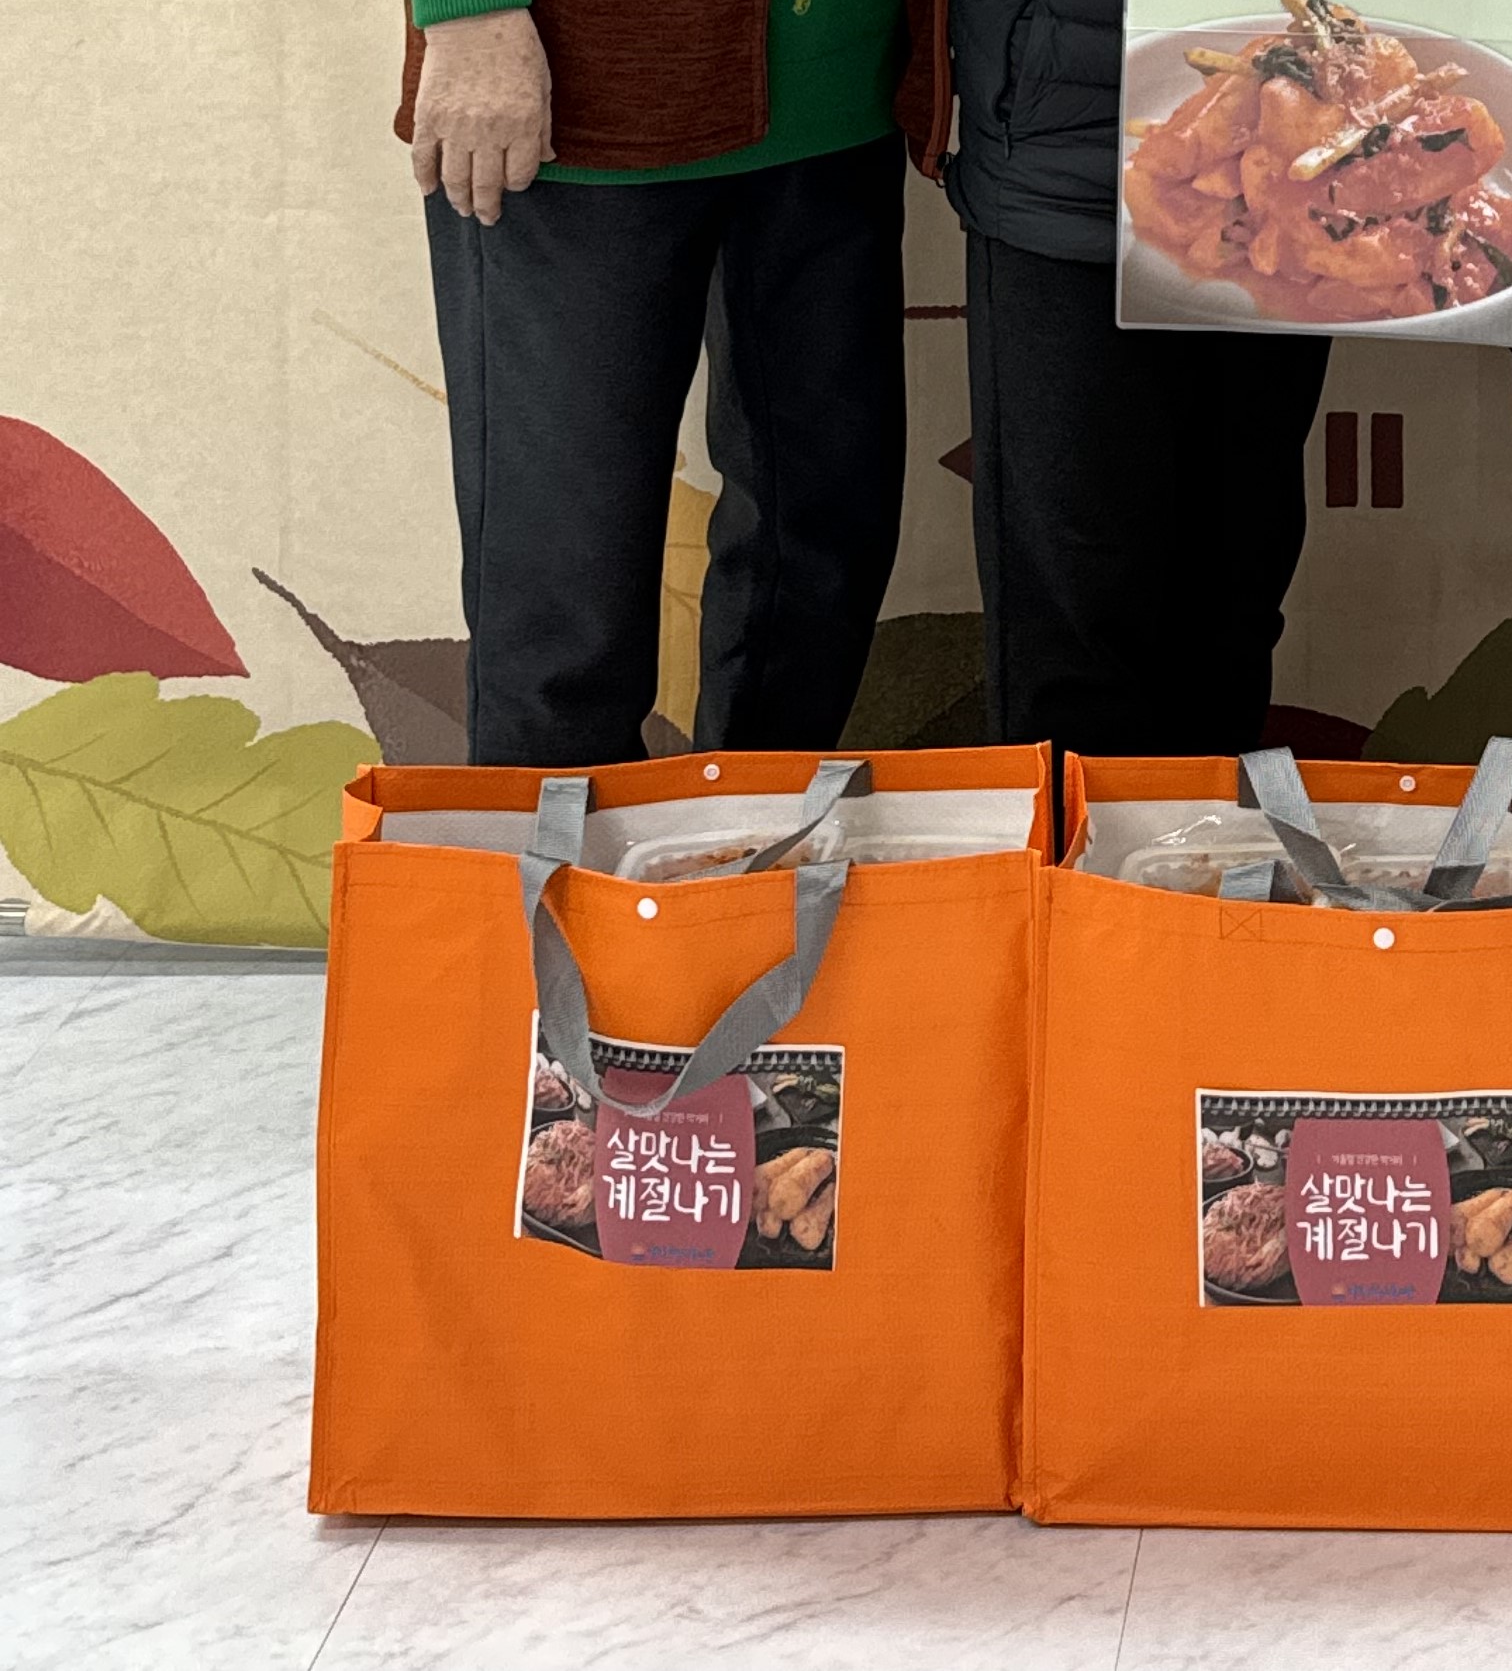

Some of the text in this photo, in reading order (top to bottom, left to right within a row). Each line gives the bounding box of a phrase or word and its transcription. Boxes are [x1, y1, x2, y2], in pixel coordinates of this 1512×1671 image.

[606, 1126, 738, 1175] 살맛나는
[601, 1174, 742, 1225] 계절나기
[1299, 1172, 1433, 1215] 살맛나는
[1295, 1216, 1440, 1262] 계절나기
